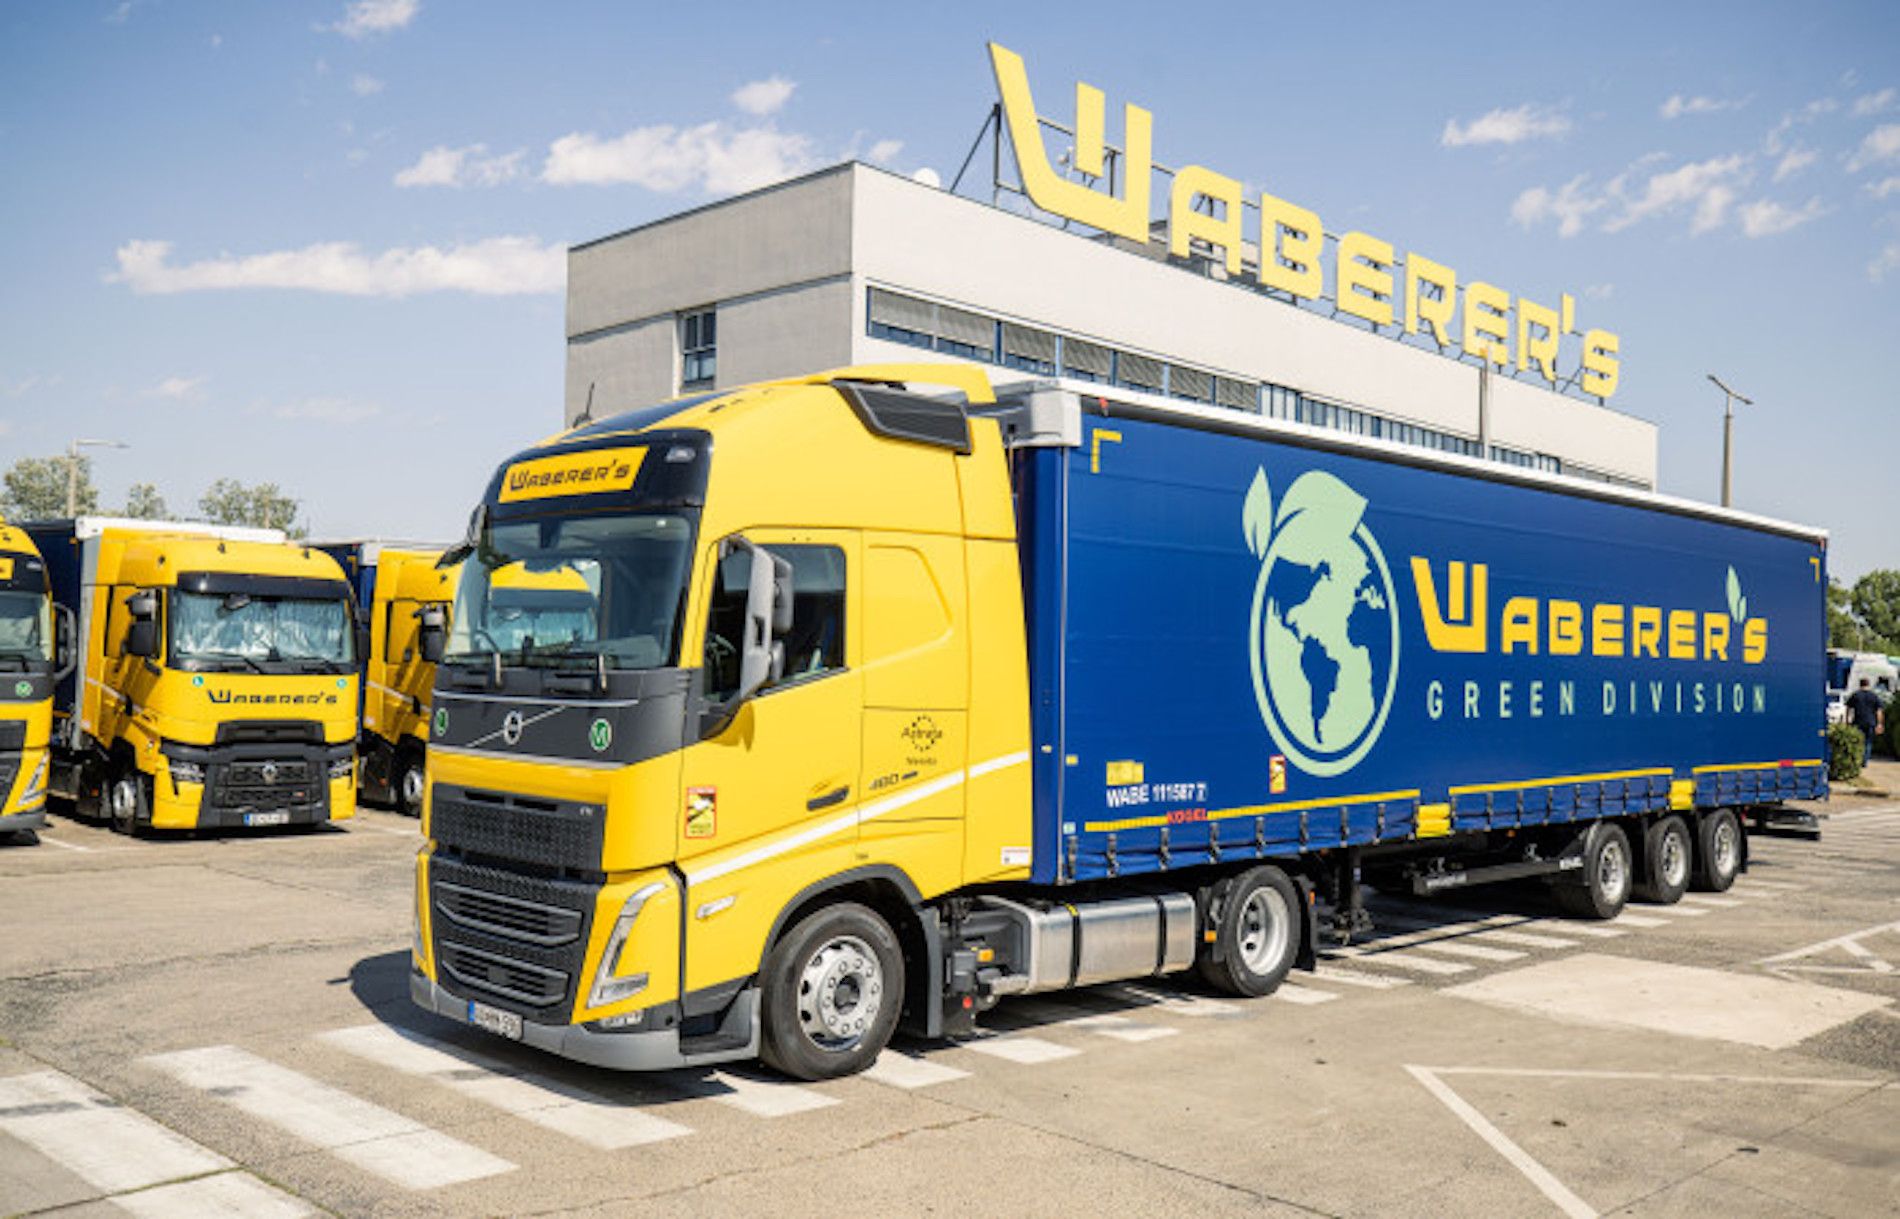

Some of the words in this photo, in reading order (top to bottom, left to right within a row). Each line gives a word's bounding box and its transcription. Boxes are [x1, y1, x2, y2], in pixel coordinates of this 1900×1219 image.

[988, 42, 1620, 399] WABERER'S
[1426, 680, 1576, 720] GREEN
[1602, 680, 1766, 716] DIVISION
[1106, 783, 1150, 808] WABE
